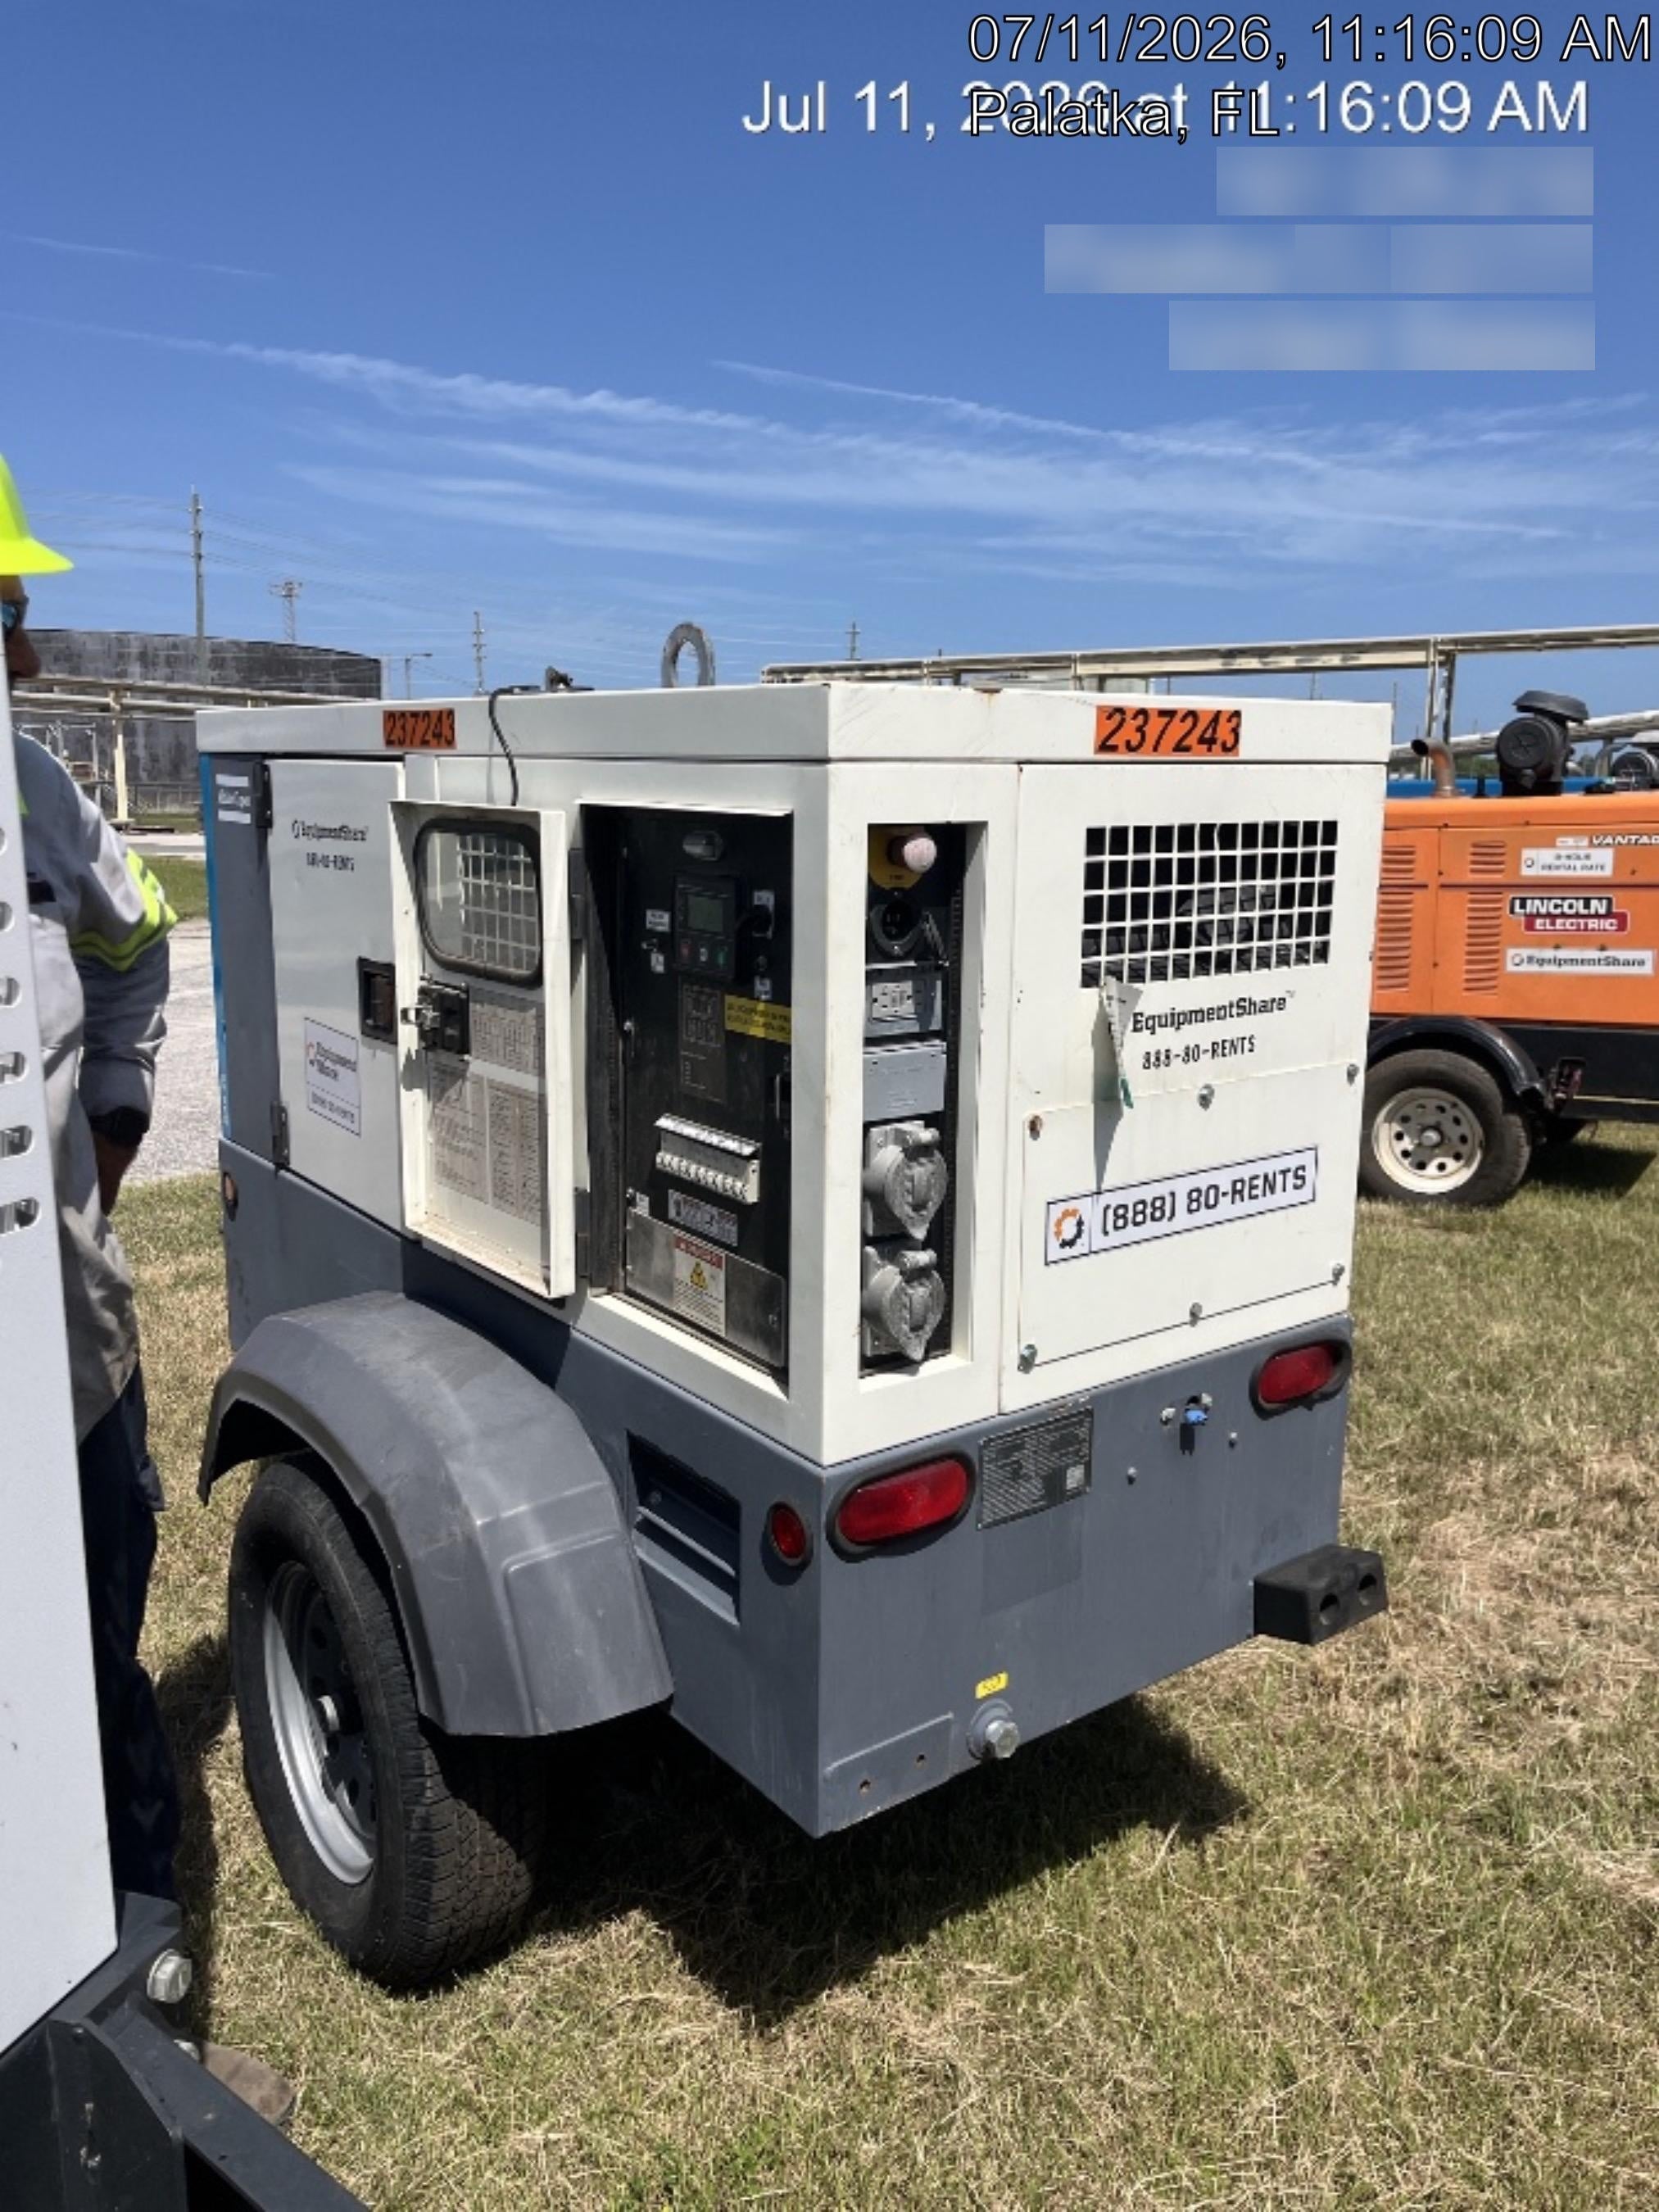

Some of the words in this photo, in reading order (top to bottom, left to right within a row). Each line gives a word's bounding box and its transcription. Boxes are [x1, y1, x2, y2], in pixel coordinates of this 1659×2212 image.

[385, 709, 456, 747] 237243
[1098, 707, 1242, 754] 237243
[1514, 899, 1608, 915] LINCOLN
[1534, 918, 1619, 931] ELECTRIC
[1526, 954, 1646, 968] EquipmentShare
[1131, 996, 1287, 1036] EquipmentShare
[1102, 1191, 1176, 1237] (888)
[1186, 1163, 1308, 1215] 80-RENTS
